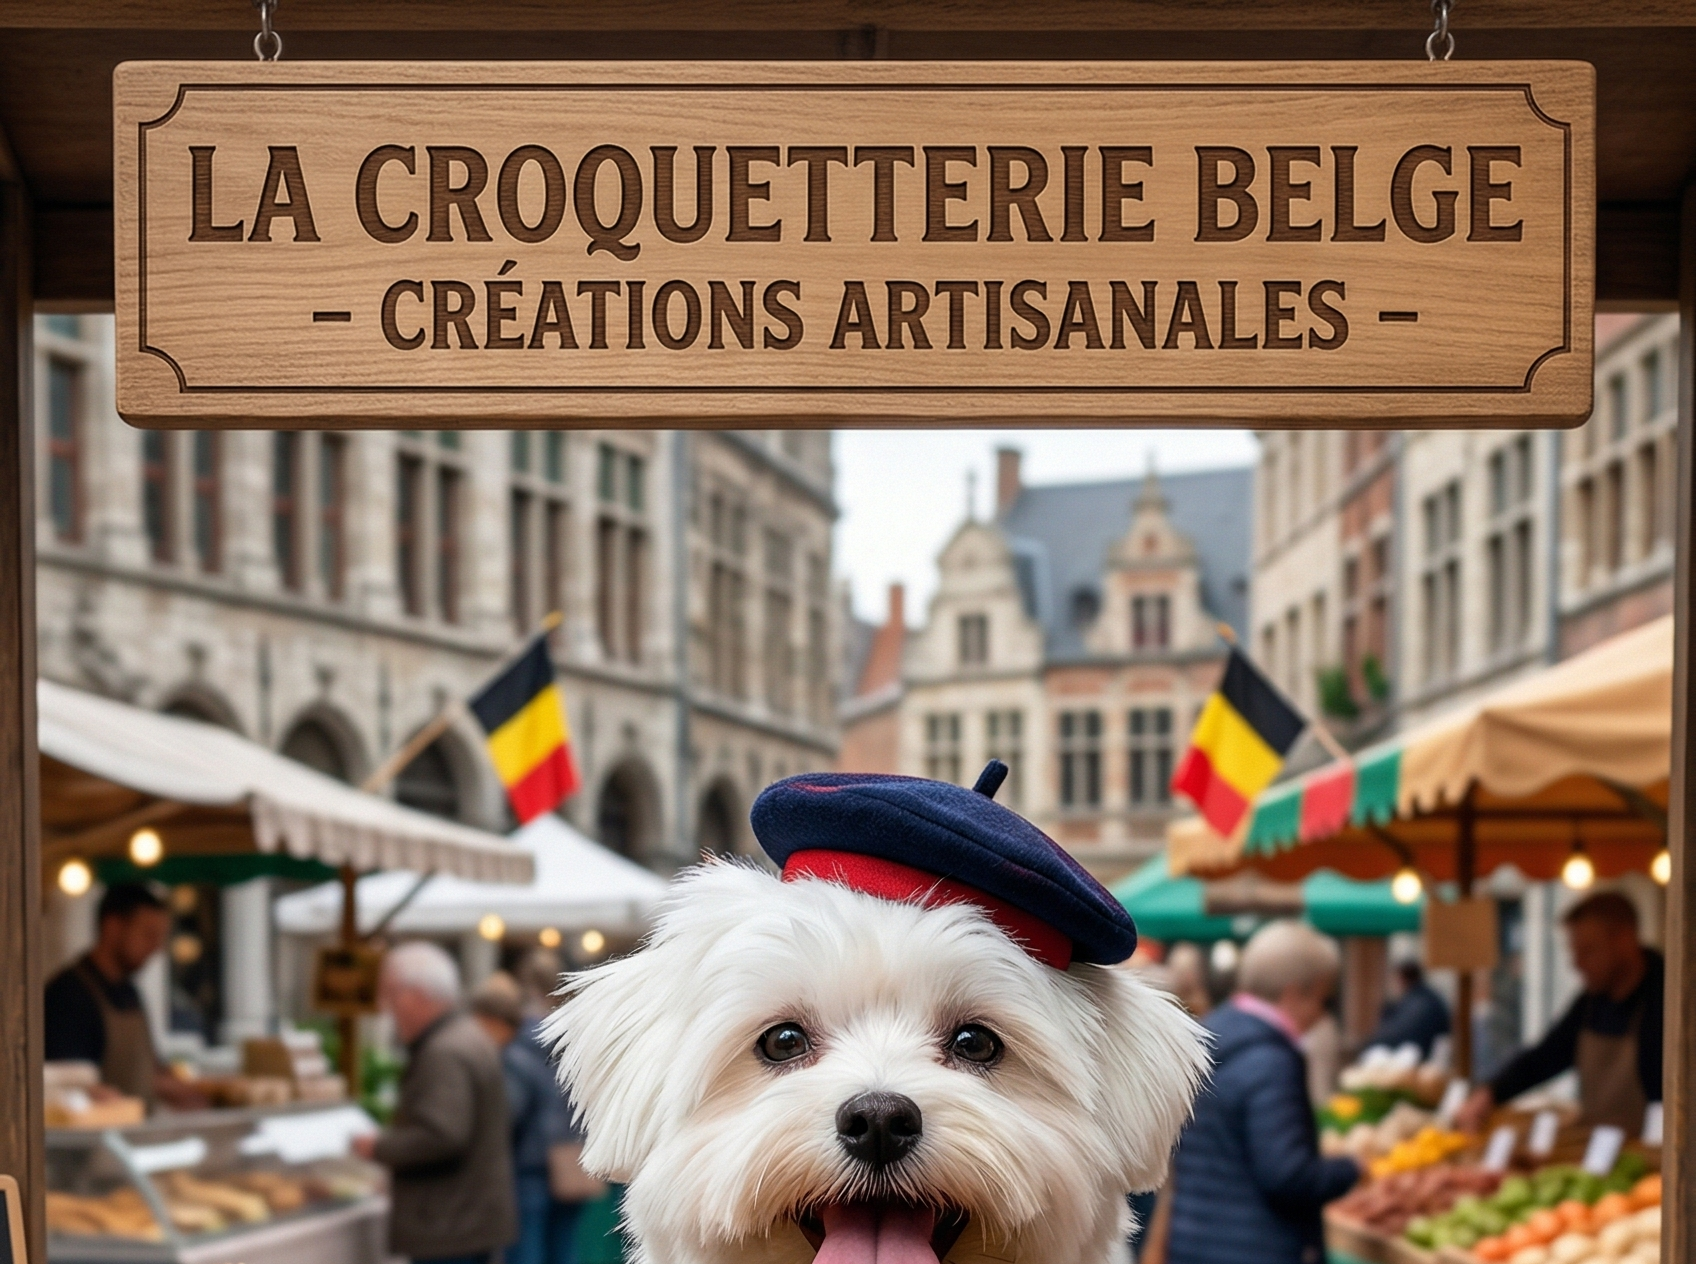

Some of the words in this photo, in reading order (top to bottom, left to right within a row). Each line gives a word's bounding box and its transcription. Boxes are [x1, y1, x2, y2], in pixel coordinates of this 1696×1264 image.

[187, 145, 322, 243] LA
[354, 143, 1157, 262] CROQUETTERIE
[1193, 143, 1525, 244] BELGE
[380, 259, 805, 351] CRÉATIONS
[828, 279, 1350, 351] ARTISANALES
